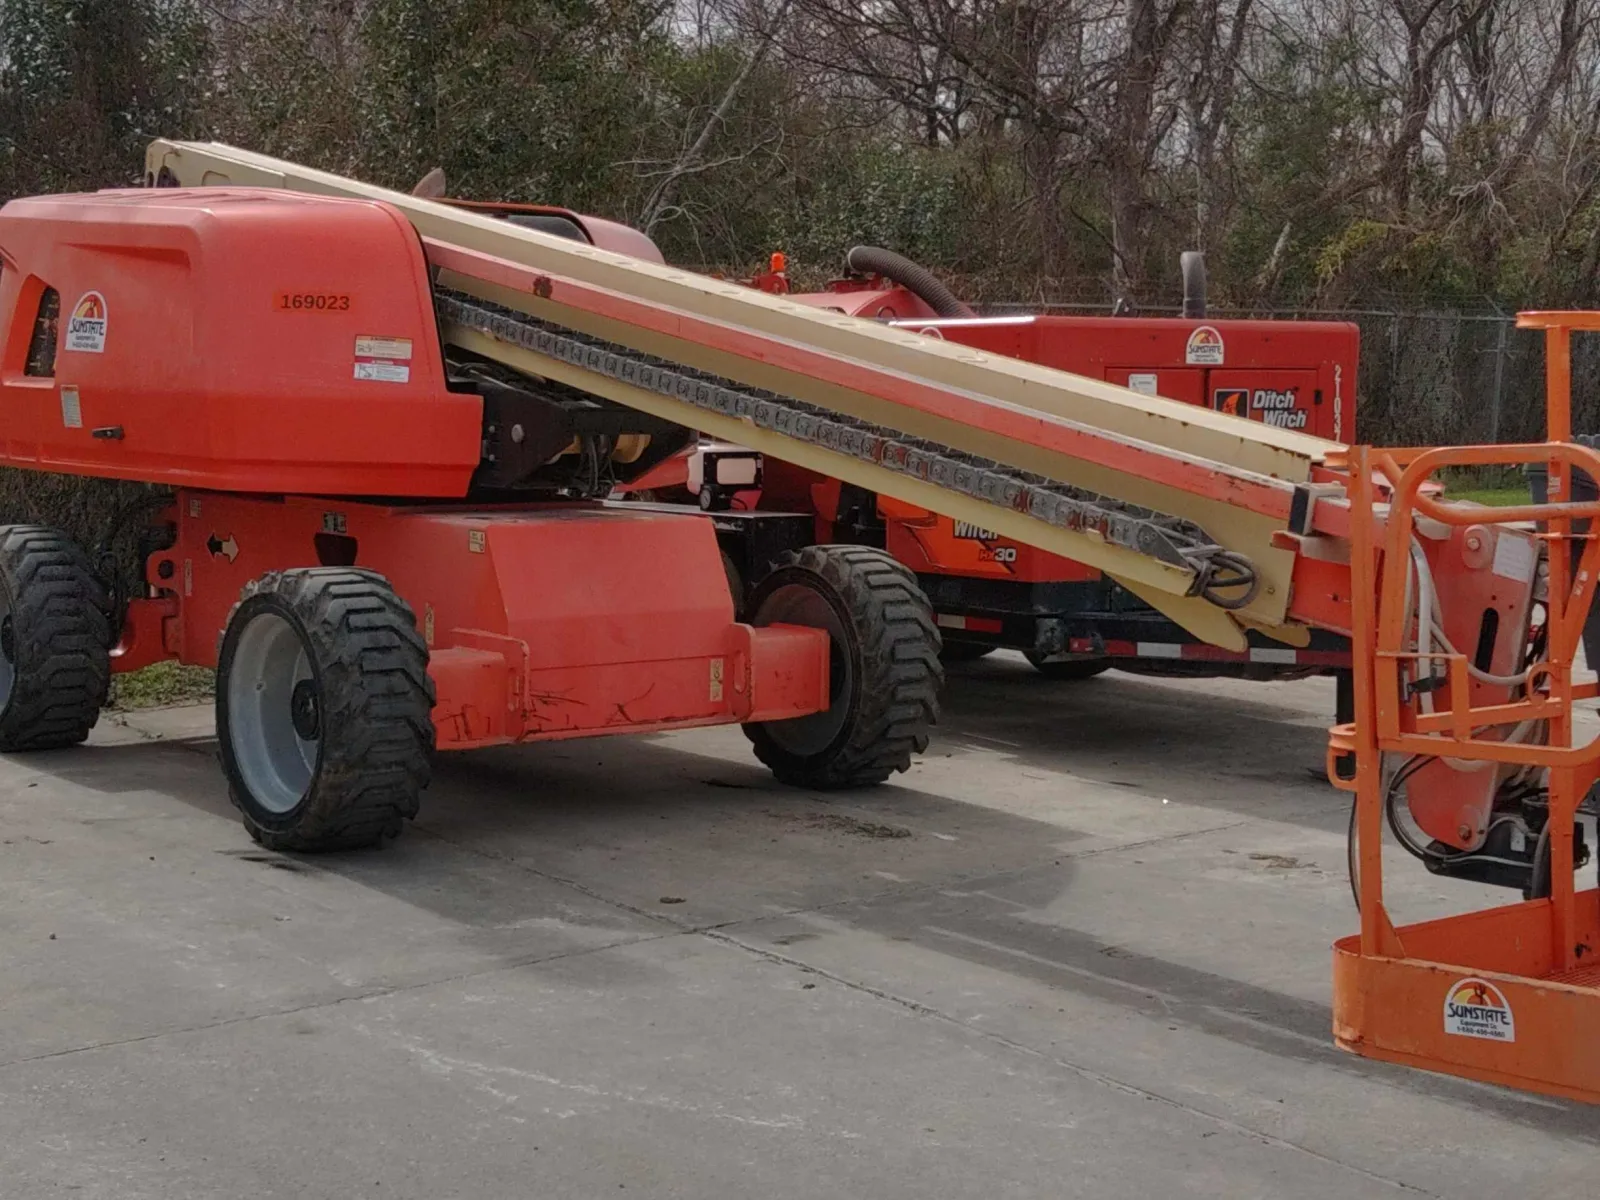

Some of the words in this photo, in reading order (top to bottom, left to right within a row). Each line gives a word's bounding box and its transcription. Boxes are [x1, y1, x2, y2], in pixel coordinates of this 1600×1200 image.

[281, 294, 350, 311] 169023
[69, 318, 105, 336] SUNSTATE
[1252, 390, 1295, 408] Ditch
[1263, 409, 1307, 427] Witch
[1448, 1002, 1510, 1025] SUNSTATE
